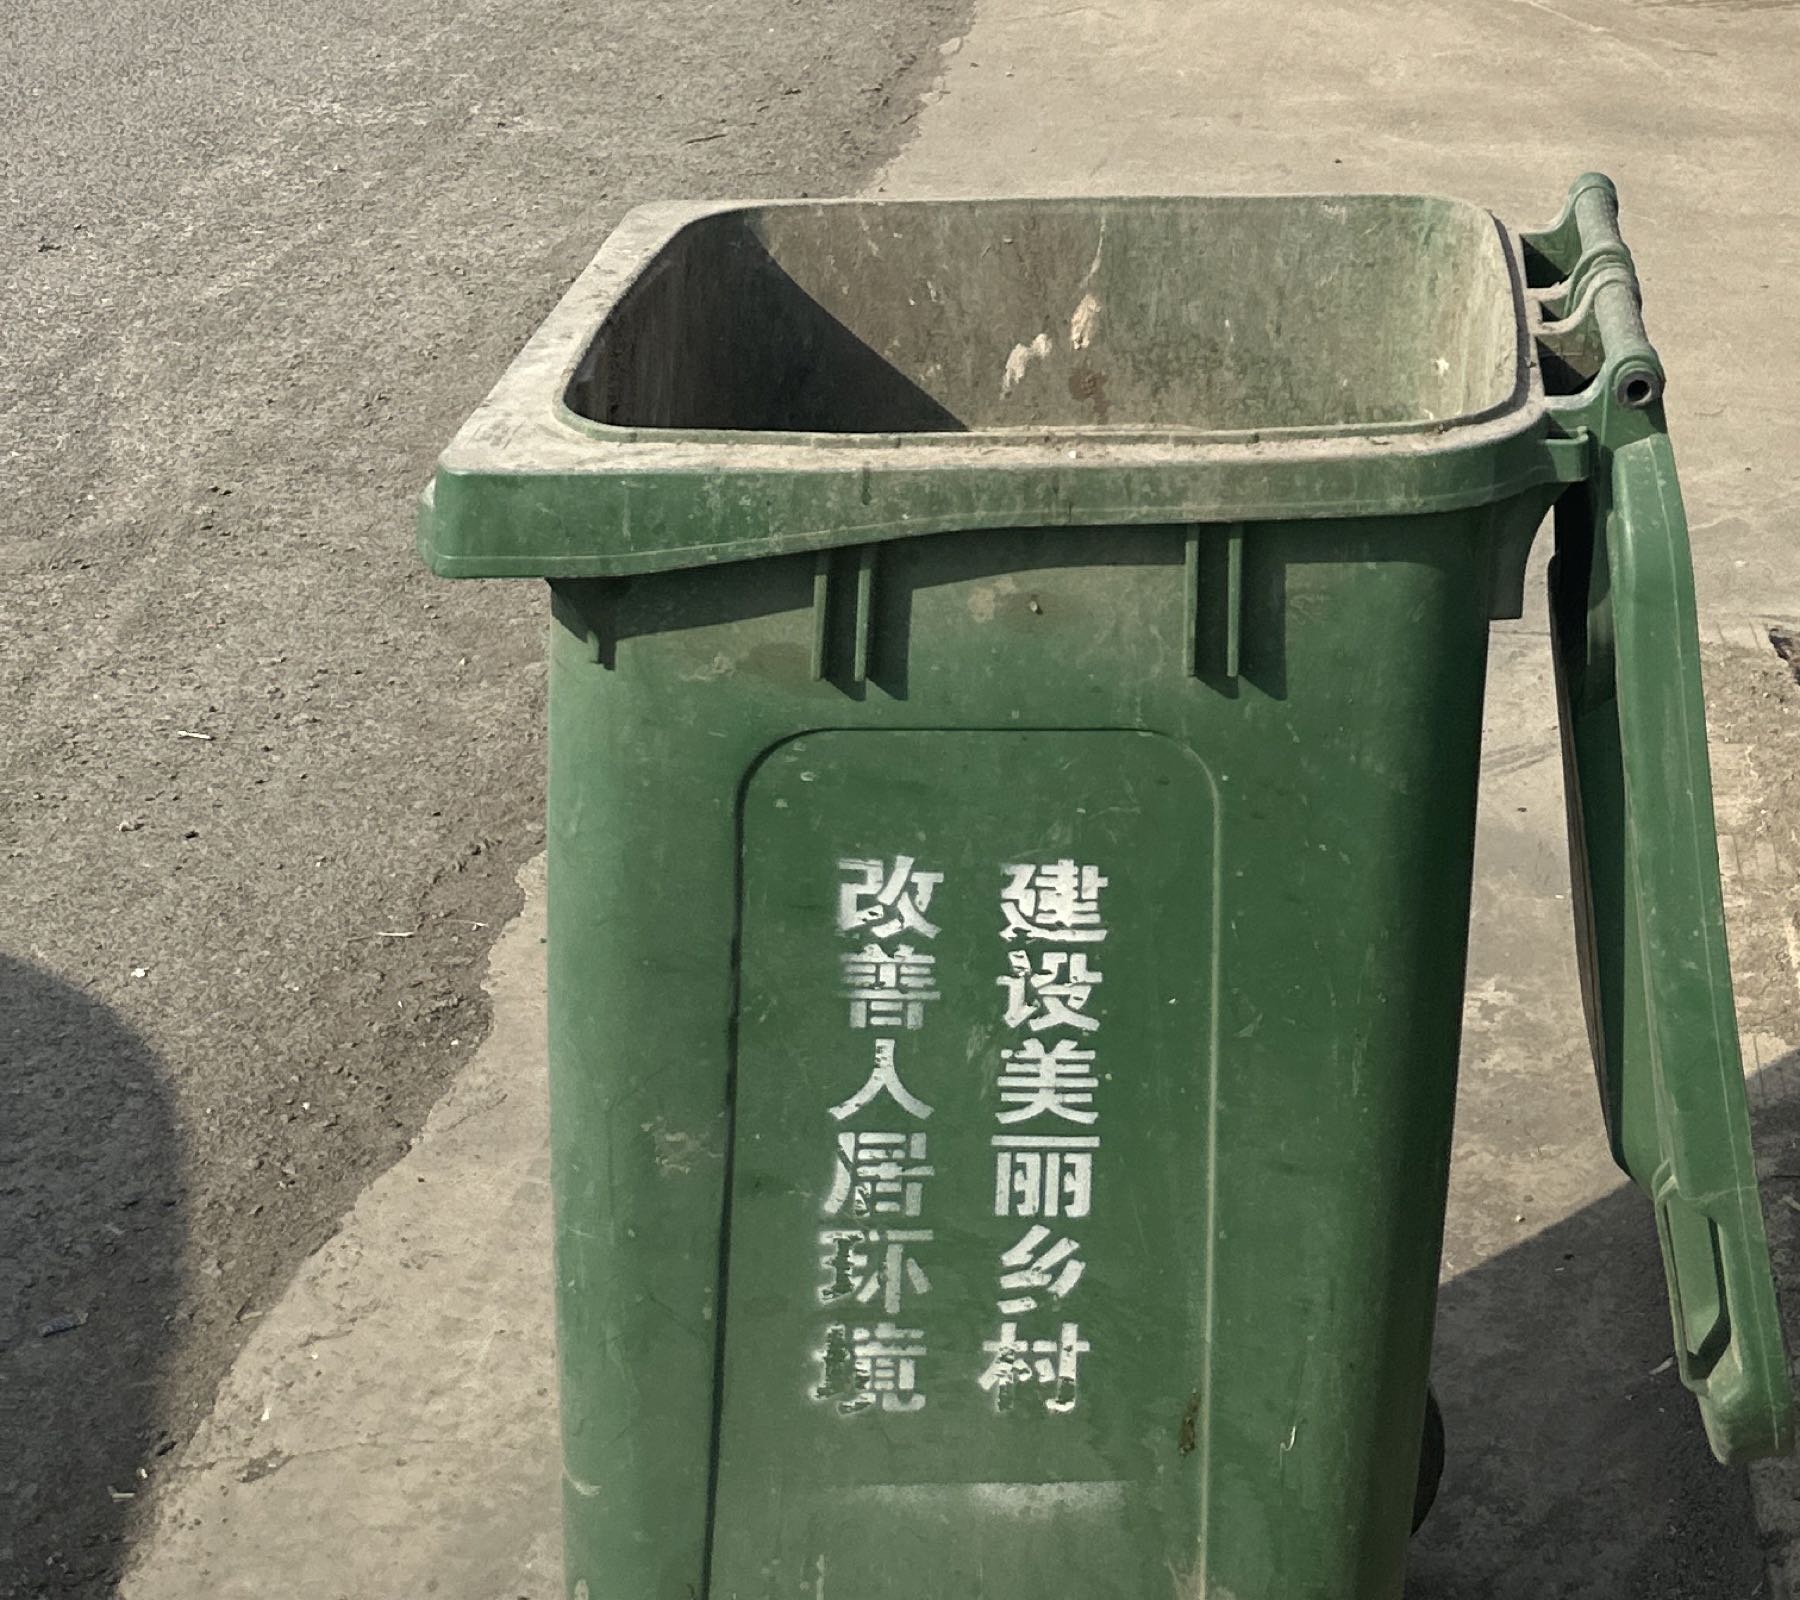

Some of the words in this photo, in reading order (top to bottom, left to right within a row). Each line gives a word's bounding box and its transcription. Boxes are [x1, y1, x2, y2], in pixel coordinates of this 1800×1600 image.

[809, 854, 945, 1414] 改善人居环境
[977, 858, 1109, 1414] 建设美丽乡村
